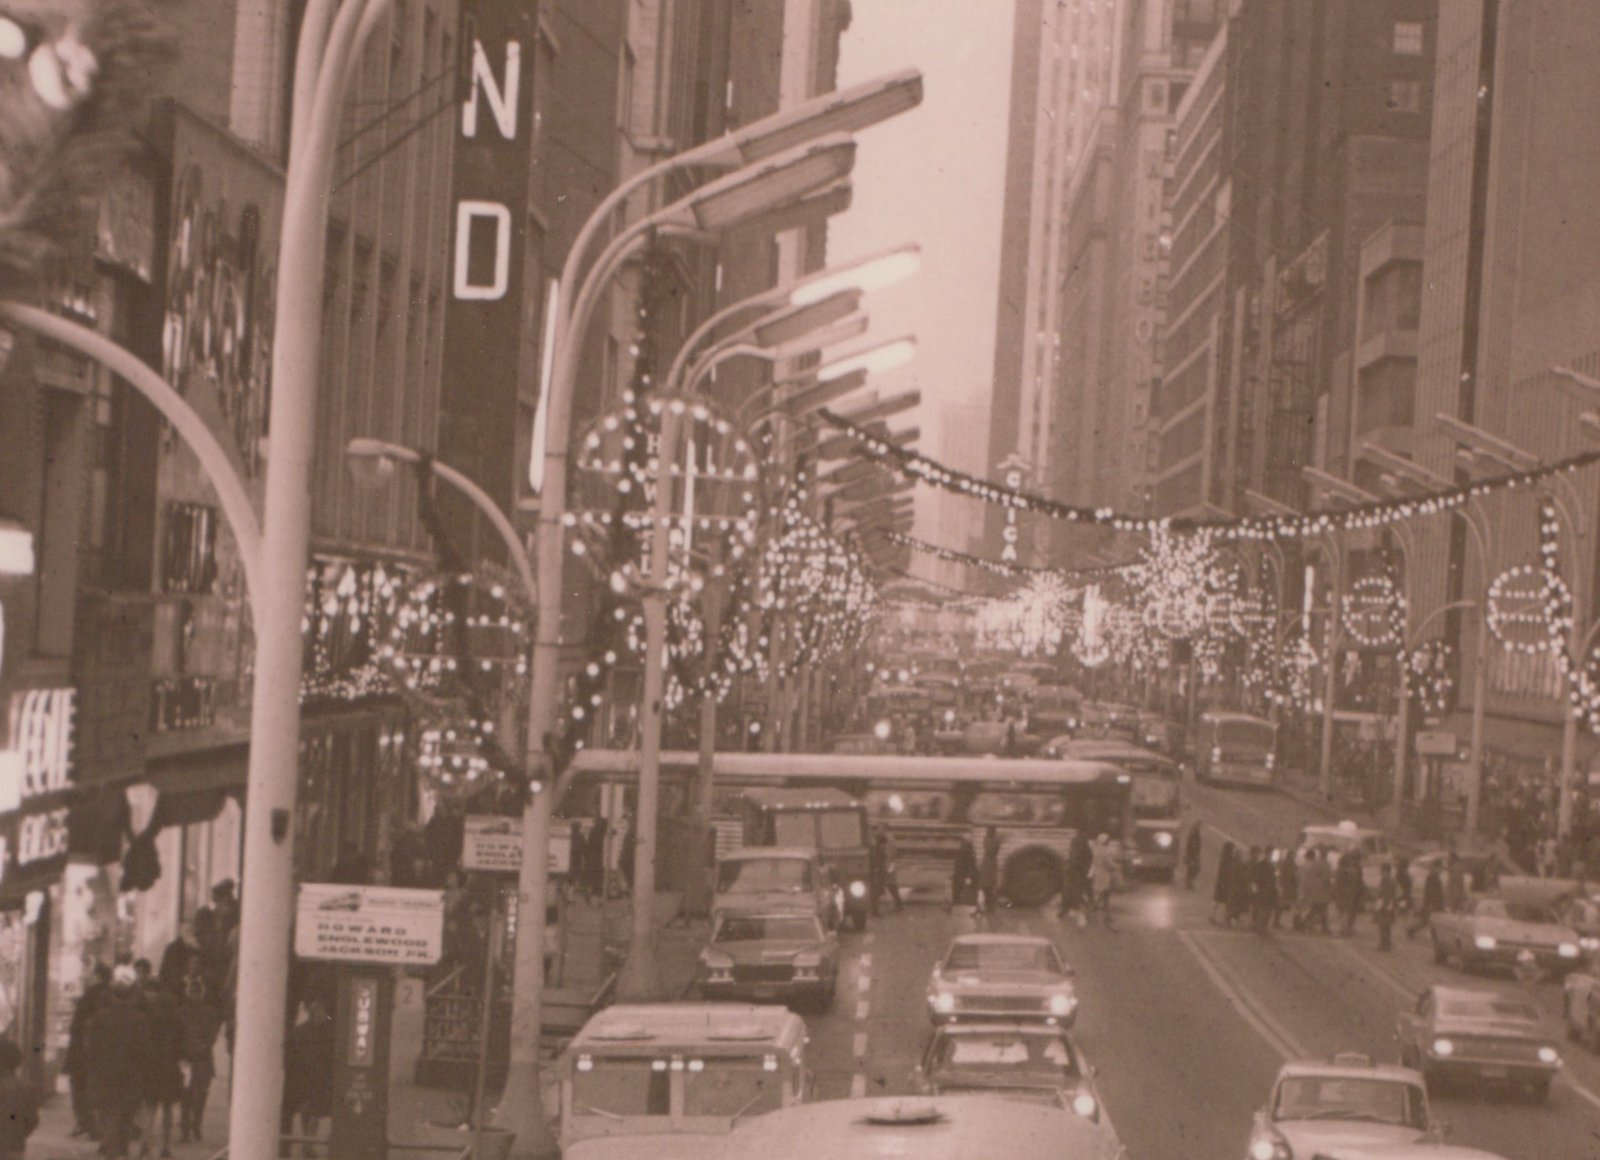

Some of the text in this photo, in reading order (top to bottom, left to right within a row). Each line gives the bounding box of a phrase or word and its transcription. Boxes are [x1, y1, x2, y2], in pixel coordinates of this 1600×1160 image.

[317, 923, 407, 935] HOWARD
[317, 934, 428, 947] ENGLEWOOD
[317, 946, 399, 956] JACKSON
[356, 988, 371, 1057] SUBWAY
